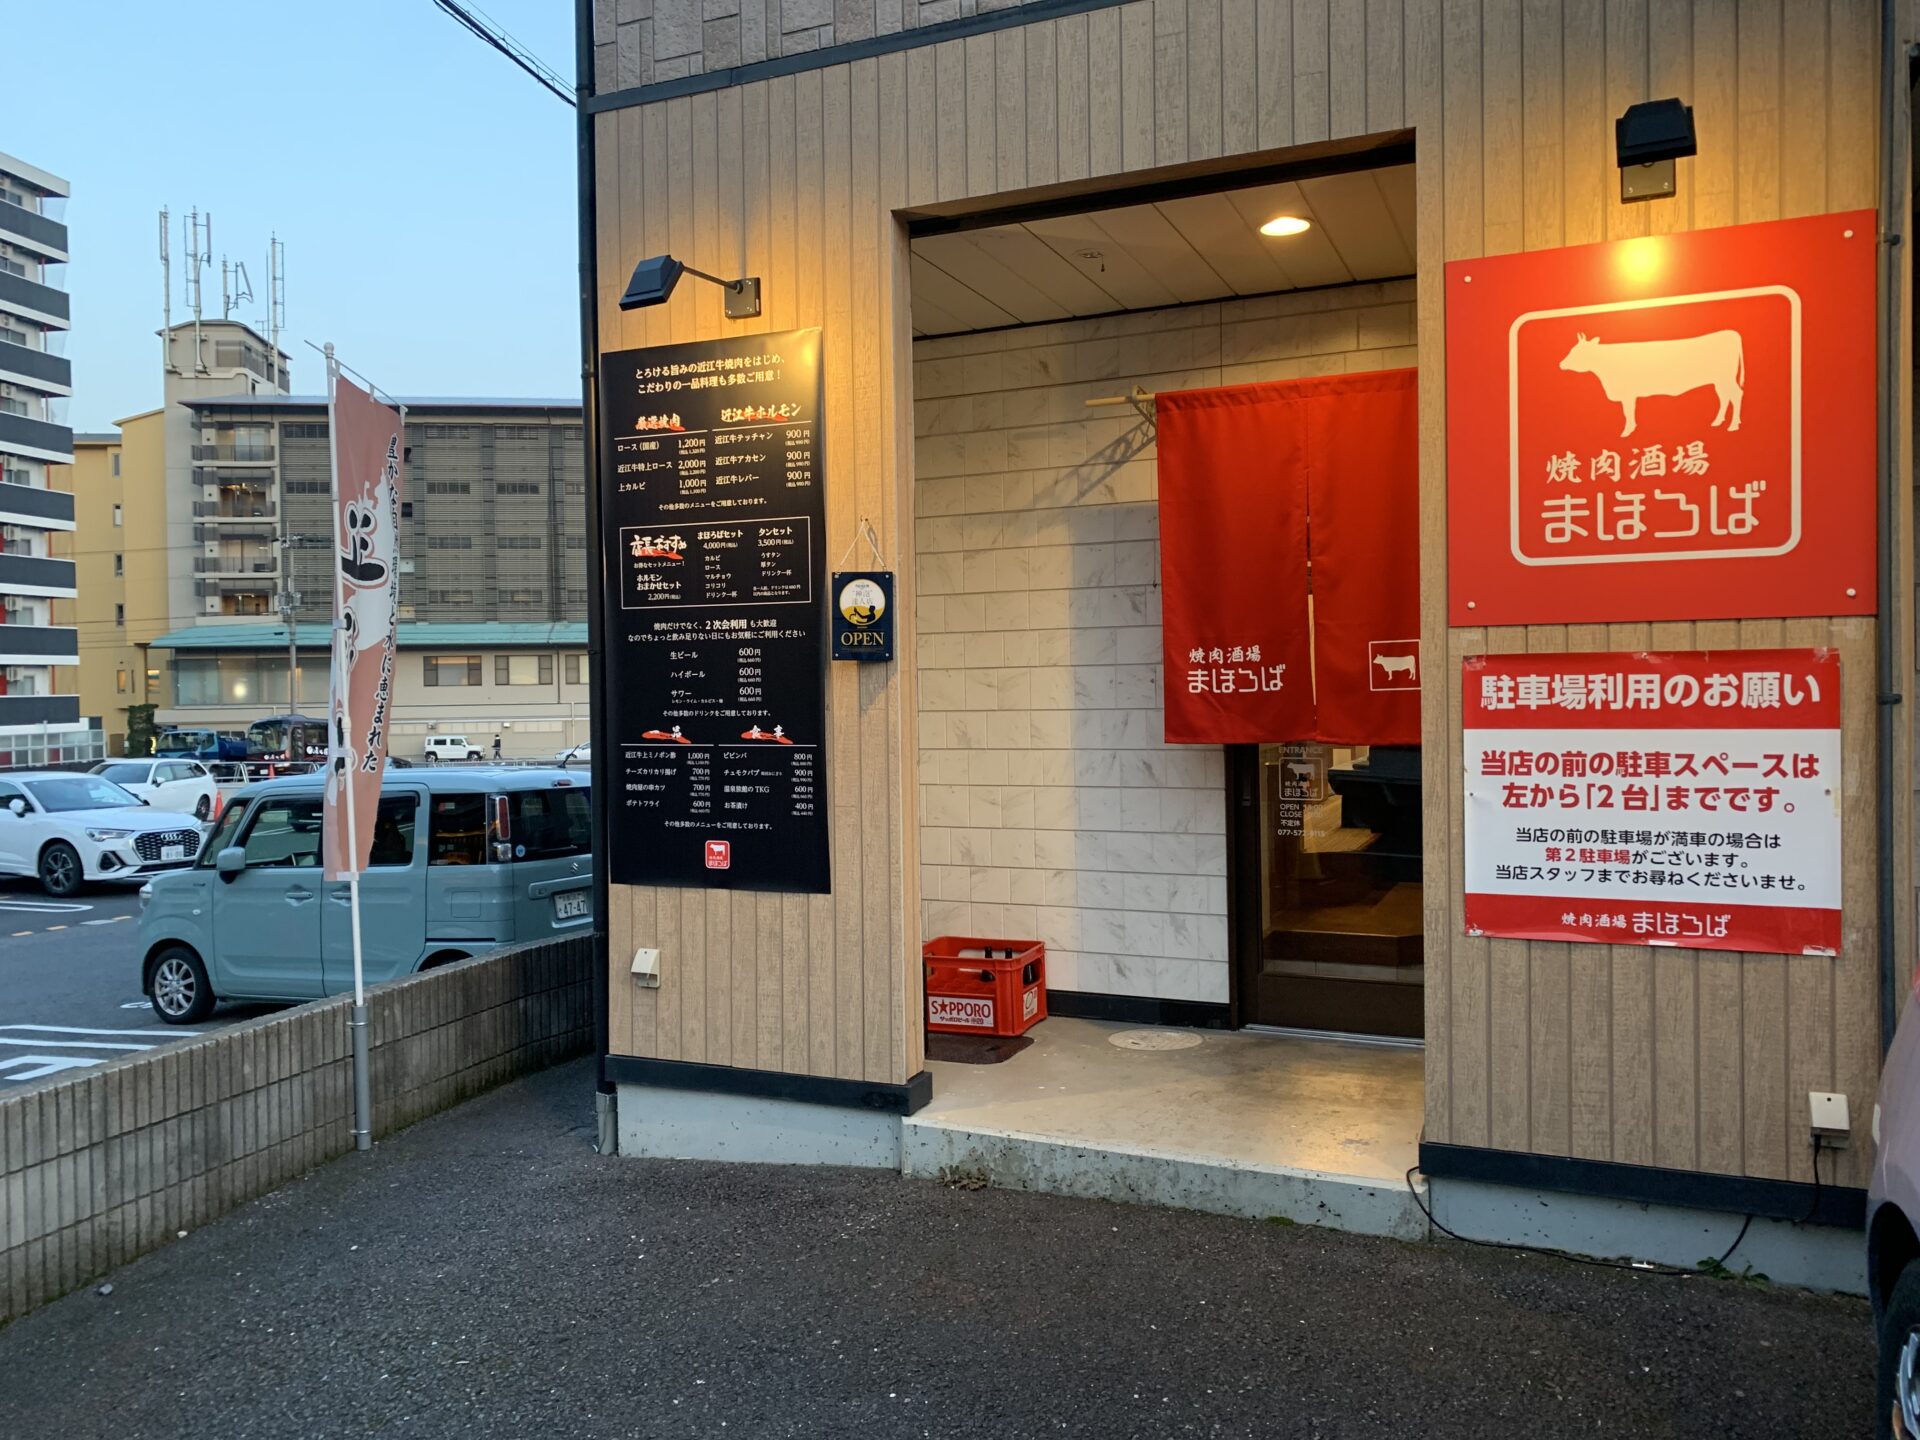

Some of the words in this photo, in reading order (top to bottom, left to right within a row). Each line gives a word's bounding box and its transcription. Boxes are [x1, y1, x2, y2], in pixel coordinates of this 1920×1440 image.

[636, 354, 785, 379] とろける旨みの近江牛焼肉をはじめ、
[638, 371, 782, 394] こだわりの一品料理も多数ご用意！
[720, 404, 801, 422] 近江牛ホルモン
[714, 432, 774, 445] 近江牛テッチャン
[618, 461, 673, 474] 近江牛特上ロース
[715, 454, 766, 466] 近江牛アカセン
[1546, 440, 1710, 484] 焼肉酒場
[618, 481, 646, 492] 上カルビ
[716, 474, 760, 486] 近江牛レバー
[1540, 480, 1766, 544] まほろば
[697, 529, 744, 540] まほろばセット
[758, 527, 792, 536] タンセット
[704, 554, 720, 562] カルビ
[636, 574, 662, 582] ホルモン
[636, 582, 682, 591] おまかせセット
[841, 632, 885, 646] OPEN
[670, 651, 698, 660] 生ビール
[1189, 644, 1261, 664] 焼肉酒場
[670, 670, 706, 678] ハイボール
[1187, 664, 1286, 694] まほろば
[1480, 671, 1821, 710] 駐車場利用のお願い
[1480, 750, 1820, 778] 当店の前の駐車スペースは
[1502, 783, 1795, 814] 左から「2台」までです。
[1516, 827, 1782, 848] 当店の前の駐車場が満車の場合は
[1545, 847, 1749, 868] 第2駐車場がございます。
[1496, 864, 1806, 891] 当店スタッフまでお尋ねくださいませ。
[564, 900, 585, 916] 47-47
[1561, 912, 1627, 929] 焼肉酒場
[1632, 912, 1732, 936] まほろば
